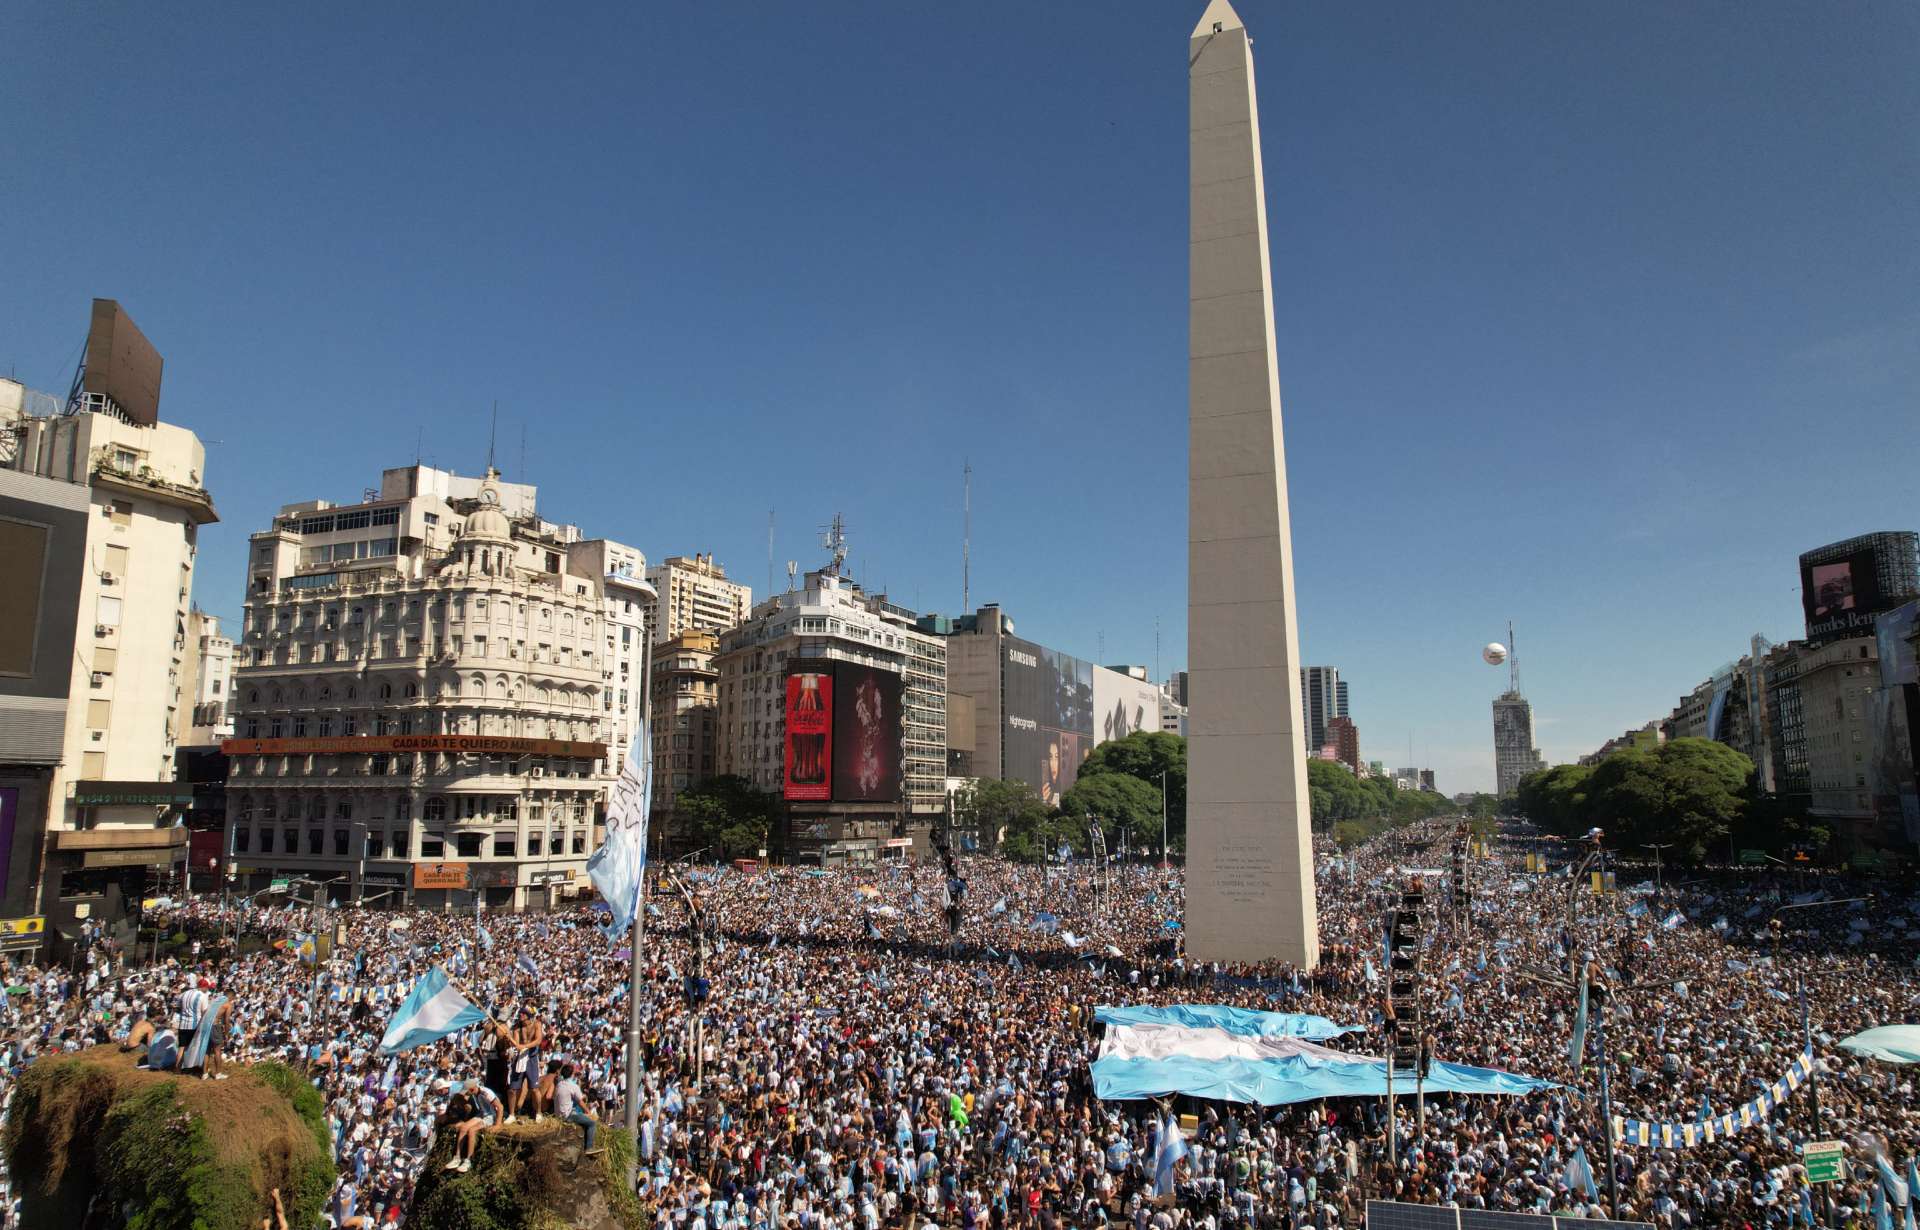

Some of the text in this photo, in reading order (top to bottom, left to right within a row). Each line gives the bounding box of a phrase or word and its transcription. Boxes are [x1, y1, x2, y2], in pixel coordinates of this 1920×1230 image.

[1009, 649, 1037, 668] SAMSUNG
[1009, 714, 1037, 731] Nightography
[393, 738, 419, 749] CADA
[442, 738, 457, 748] TE
[460, 738, 508, 750] QUIERO
